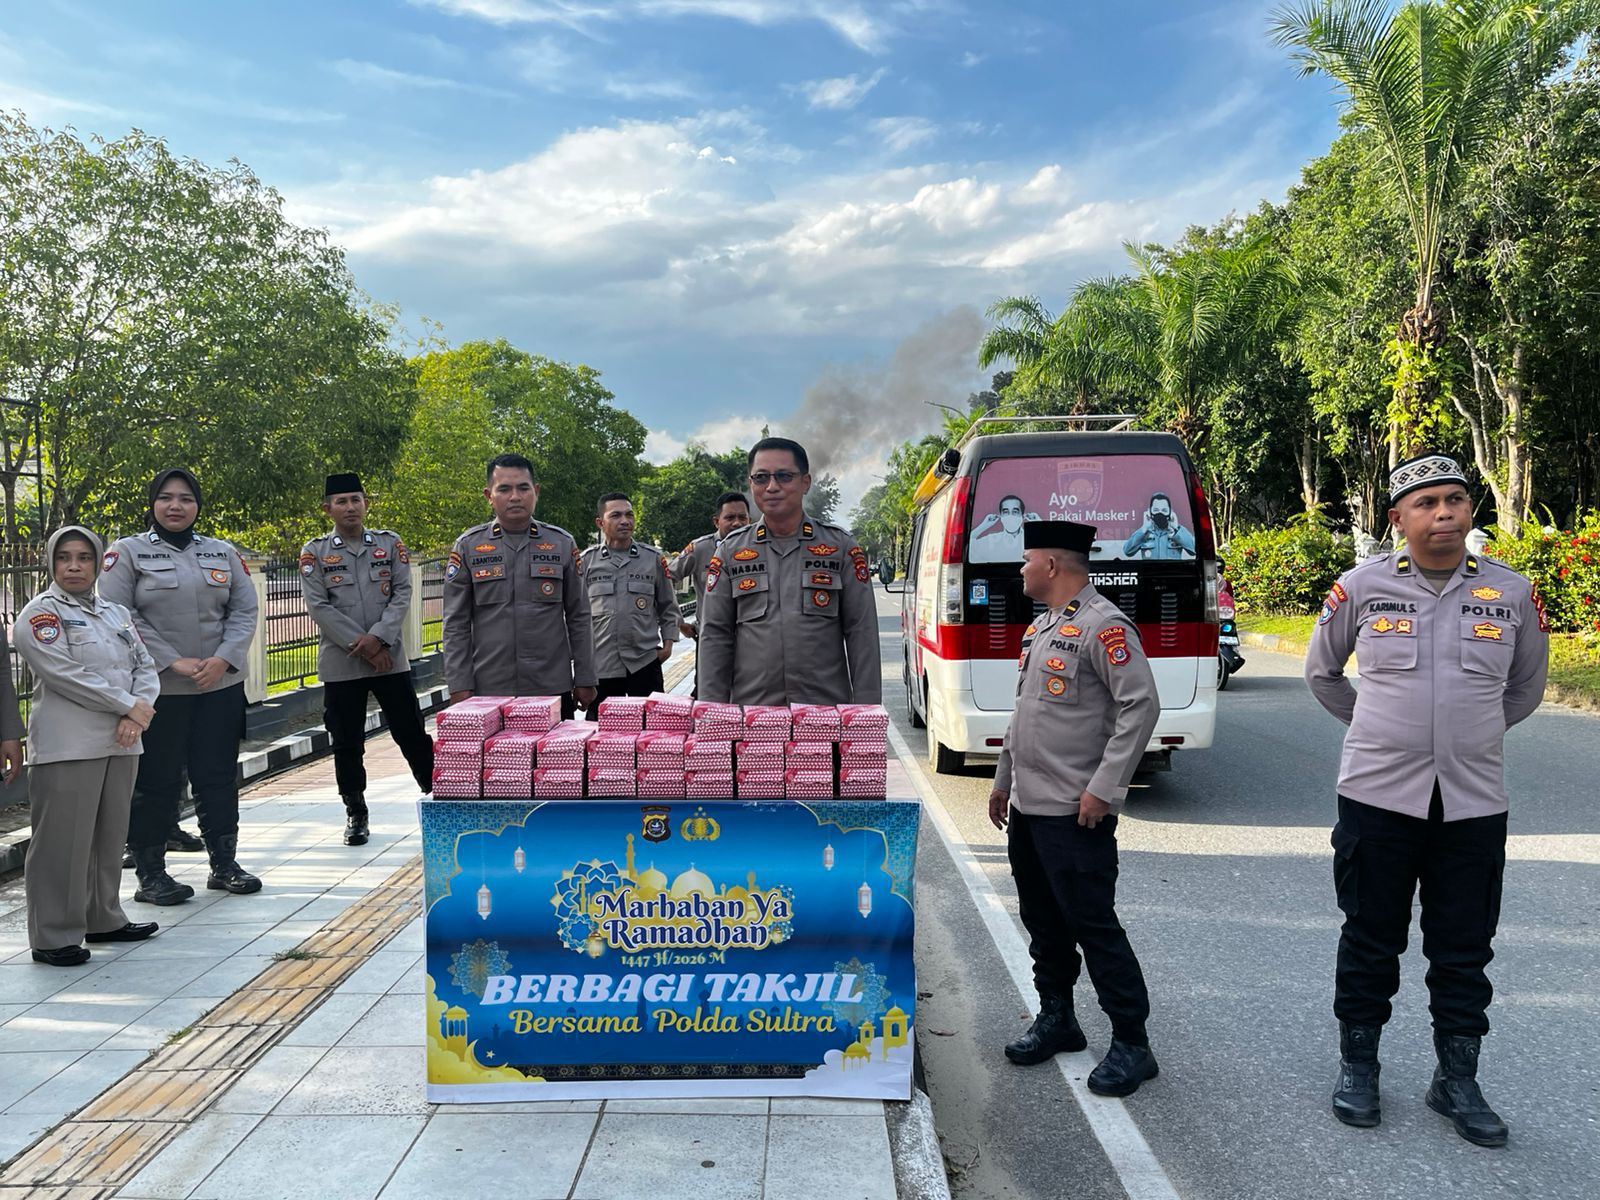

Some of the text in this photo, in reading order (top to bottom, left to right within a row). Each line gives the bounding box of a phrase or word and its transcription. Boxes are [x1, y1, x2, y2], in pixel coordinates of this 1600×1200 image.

[1049, 492, 1078, 509] Ayo
[1049, 509, 1082, 522] Pakai
[1086, 510, 1129, 521] Masker
[533, 554, 560, 562] POLRI
[805, 559, 840, 572] POLRI
[731, 563, 765, 577] NASAR
[1369, 601, 1407, 613] KARIMUL
[1461, 604, 1511, 620] POLRI
[1100, 627, 1123, 640] POLDA
[1049, 639, 1079, 654] POLRI
[594, 888, 789, 924] Marhaban Ya
[603, 917, 768, 950] Ramadhan
[621, 954, 651, 968] 1447
[708, 951, 727, 966] M
[479, 973, 864, 1005] BERBAGI TAKJIL
[508, 1006, 838, 1034] Bersama Polda Sultra
